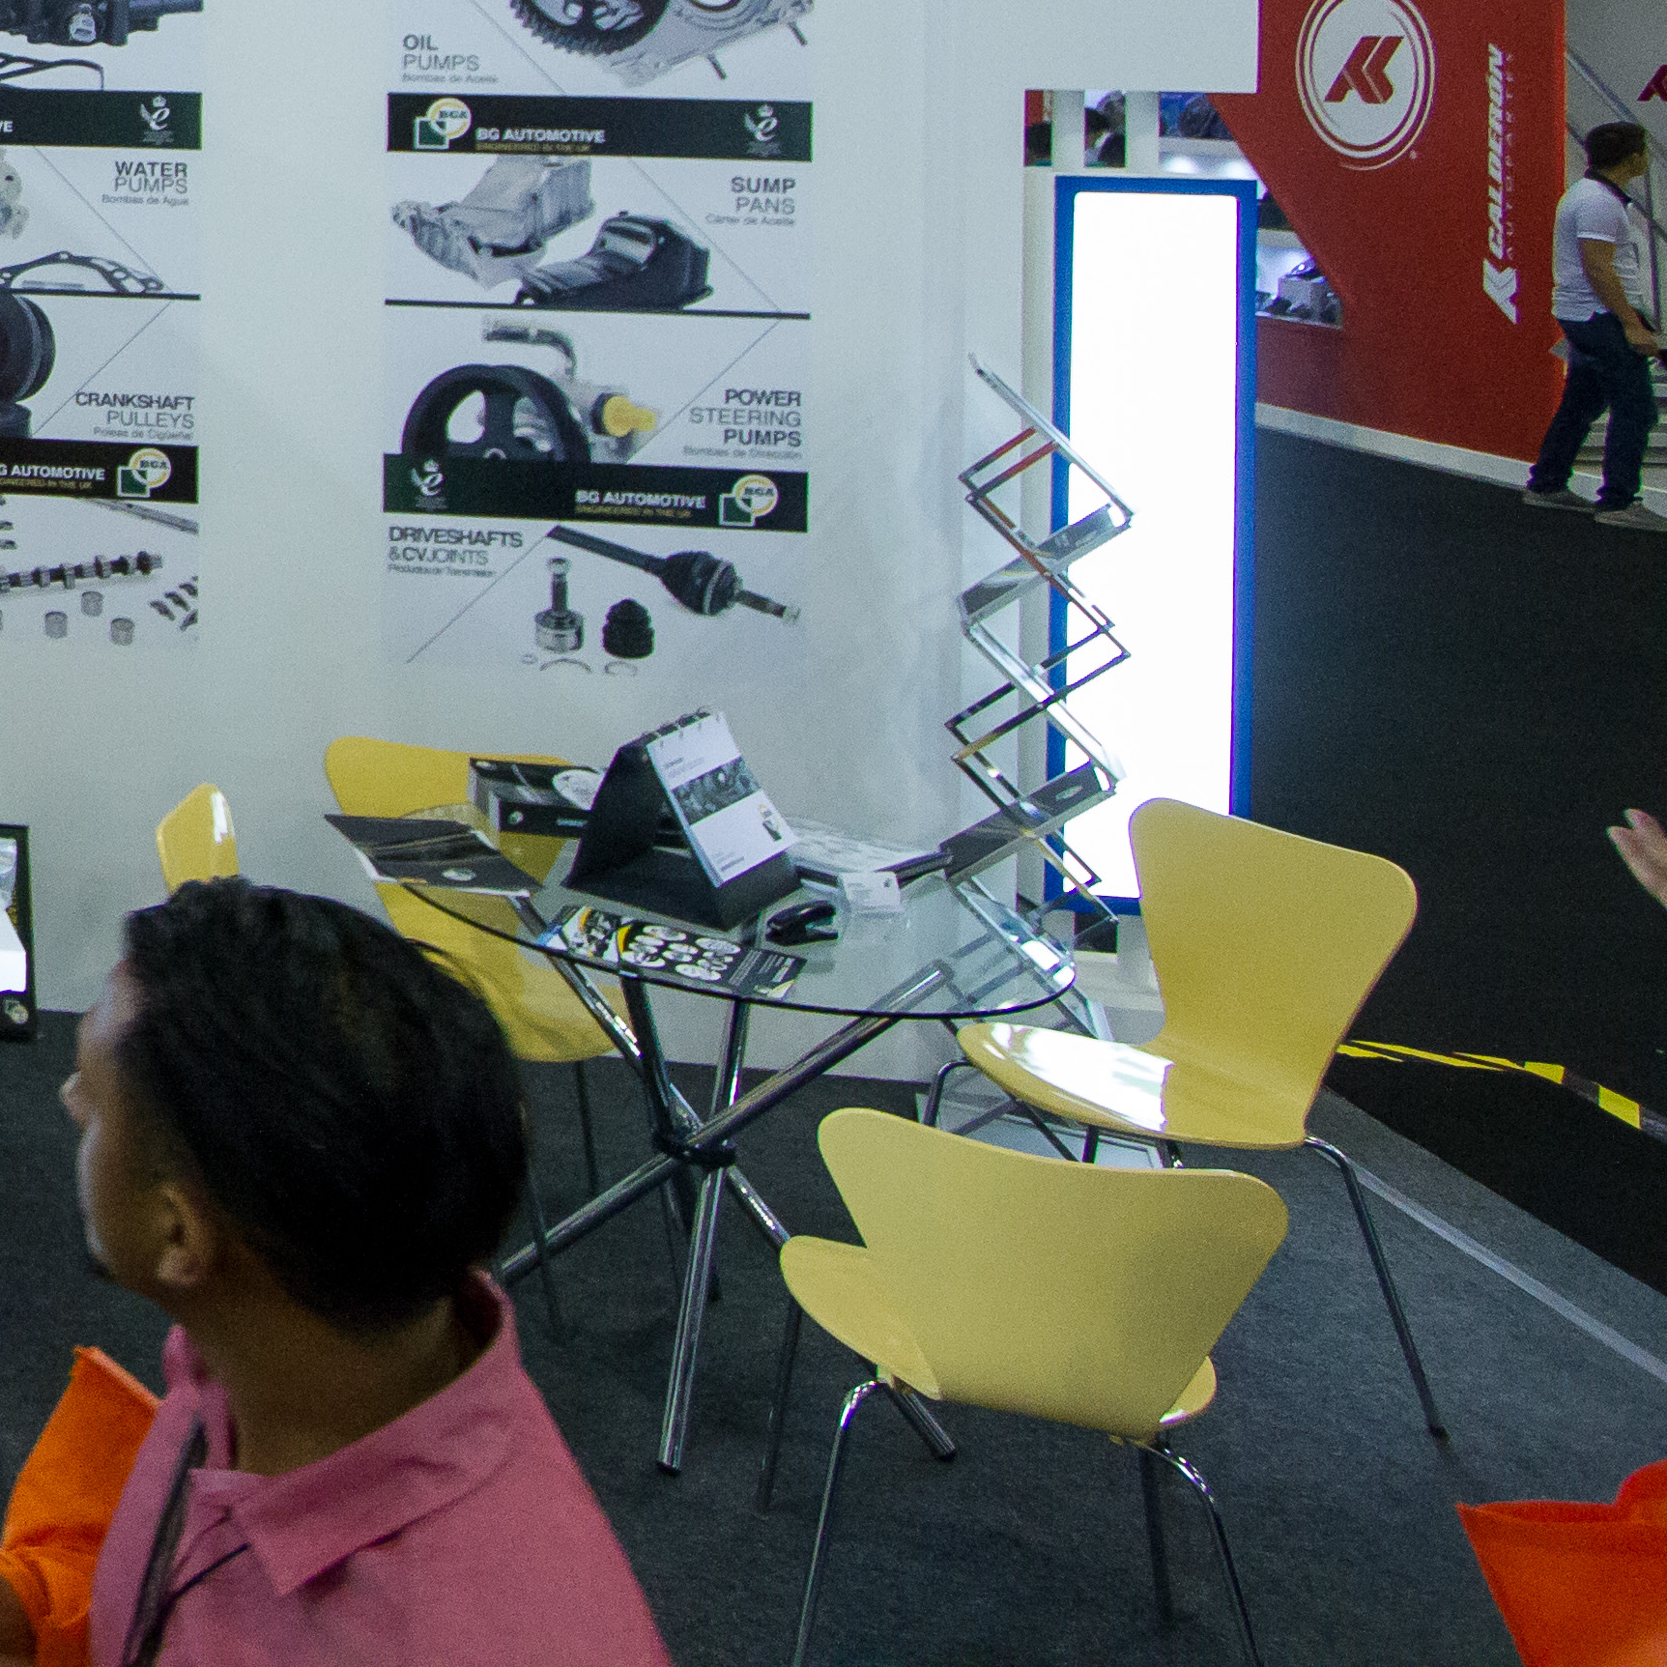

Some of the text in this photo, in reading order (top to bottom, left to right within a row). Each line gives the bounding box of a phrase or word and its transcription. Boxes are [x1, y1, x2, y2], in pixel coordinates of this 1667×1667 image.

[403, 34, 438, 51] OIL
[403, 53, 480, 71] PUMPS
[476, 127, 606, 144] BG AUTOMOTIVE
[115, 161, 188, 178] WATER
[115, 178, 188, 195] PUMPS
[731, 176, 796, 194] SUMP
[736, 196, 795, 214] PANS
[75, 391, 195, 410] CRANKSHAFT
[725, 388, 801, 407] POWER
[107, 410, 194, 430] PULLEYS
[689, 406, 801, 428] STEERING
[724, 428, 802, 448] PUMPS
[11, 464, 105, 481] AUTOMOTIVE
[602, 491, 706, 509] AUTOMOTIVE
[389, 526, 523, 548] DRIVESHAFTS
